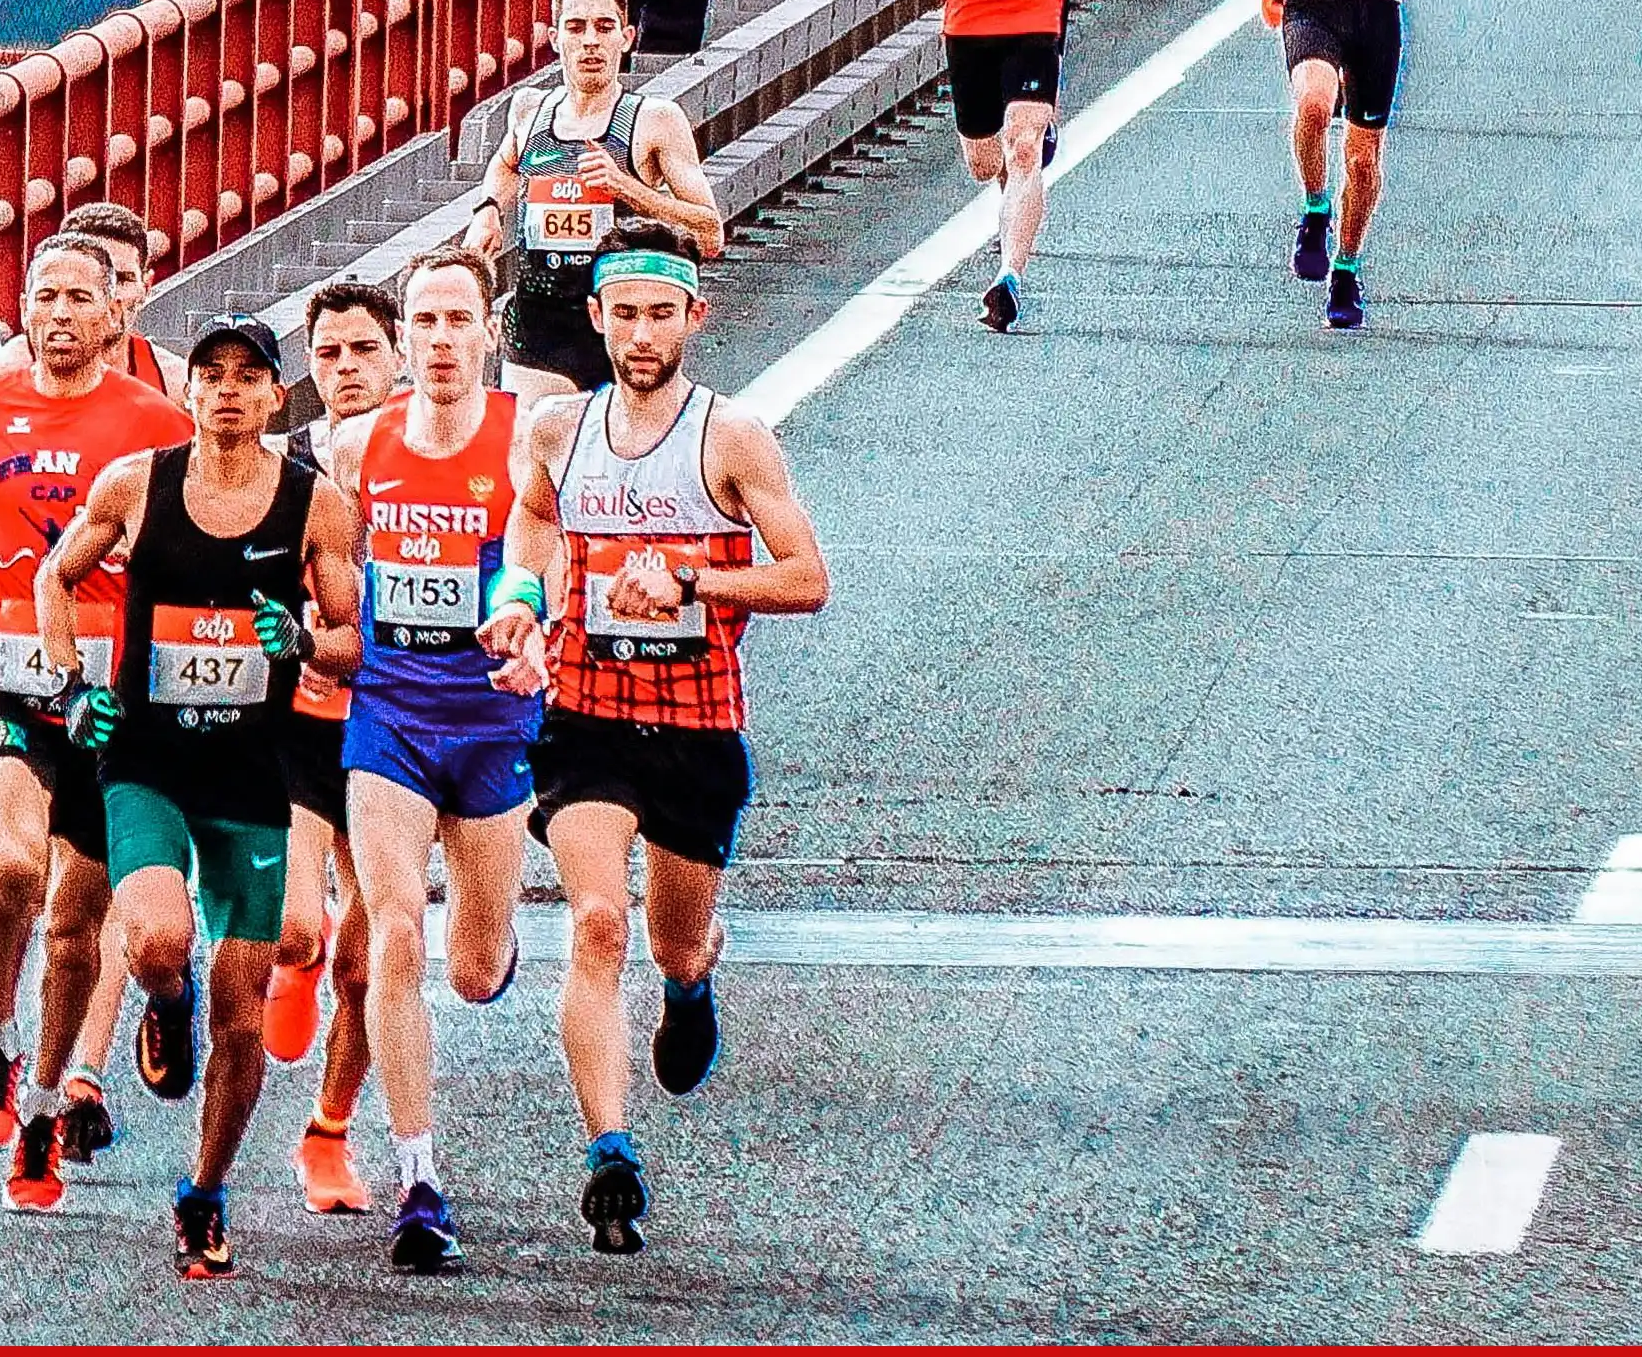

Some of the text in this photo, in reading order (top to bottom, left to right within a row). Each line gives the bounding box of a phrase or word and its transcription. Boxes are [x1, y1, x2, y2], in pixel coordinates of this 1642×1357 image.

[552, 179, 583, 202] edp
[545, 213, 592, 236] 645
[564, 255, 592, 265] MCP
[371, 501, 489, 538] RUSSIA
[399, 533, 441, 565] edp
[387, 574, 461, 606] 7153
[191, 610, 235, 646] edp
[416, 630, 451, 645] MCP
[640, 641, 677, 656] MCP
[179, 655, 243, 685] 437
[204, 708, 240, 723] MCP
